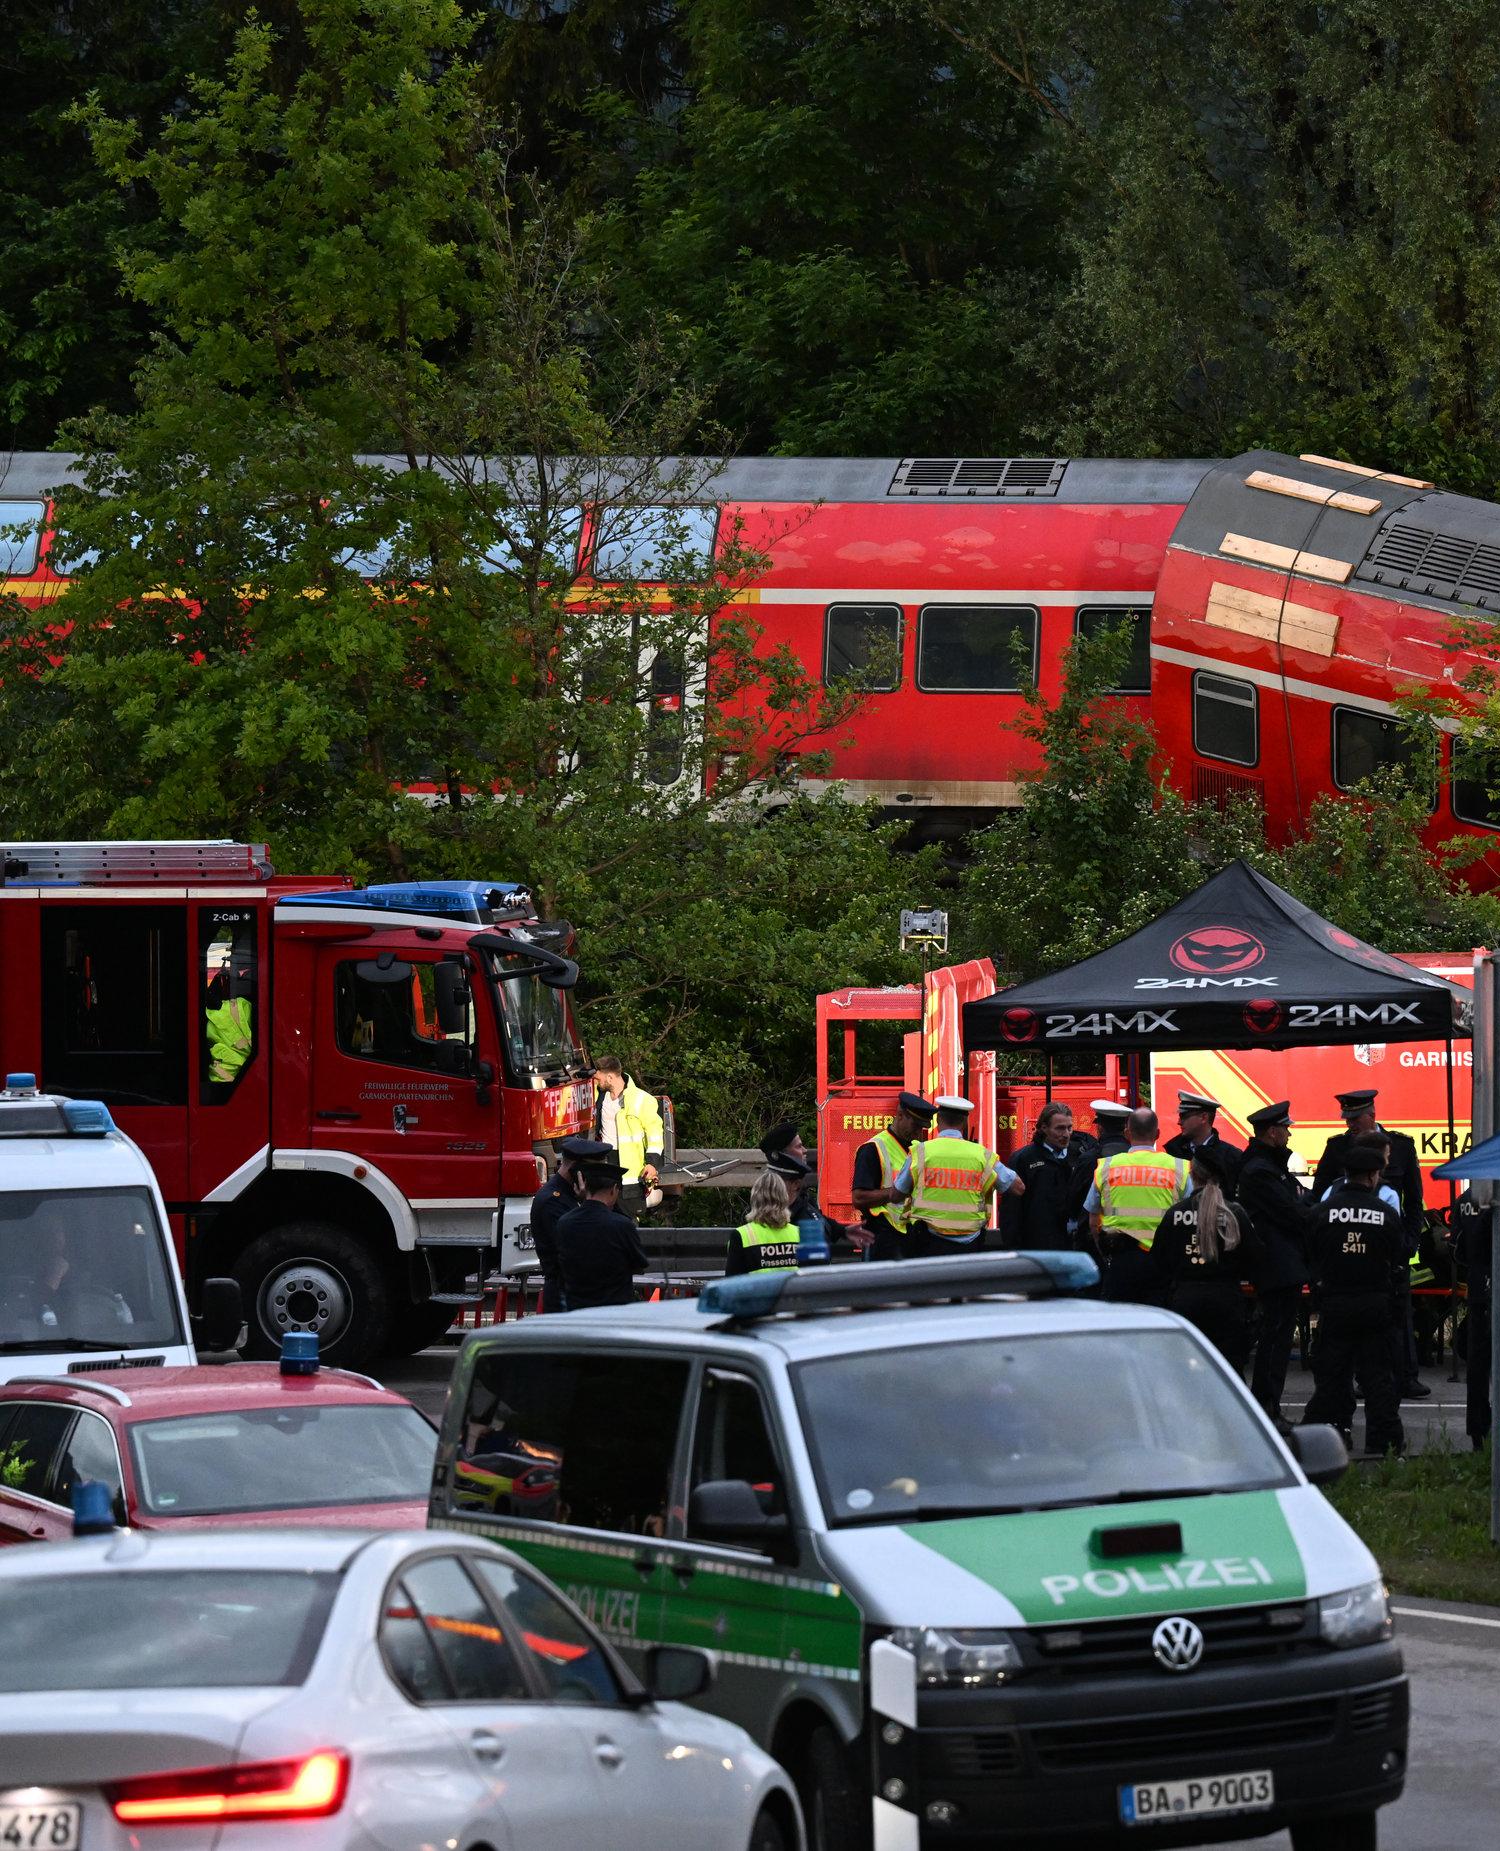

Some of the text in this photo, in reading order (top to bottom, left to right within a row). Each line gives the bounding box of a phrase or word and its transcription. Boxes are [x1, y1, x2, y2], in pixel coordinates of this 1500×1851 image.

[213, 913, 240, 921] Z-Cab
[1133, 976, 1280, 990] 24MX
[1045, 1009, 1182, 1038] 24MX
[1287, 1001, 1425, 1028] 24MX
[364, 1082, 449, 1091] FREIWILLIGE FEUERWEHR
[1328, 1207, 1385, 1226] POLIZEI
[1347, 1232, 1362, 1242] BY
[1342, 1243, 1366, 1254] 5411
[1041, 1557, 1274, 1606] POLIZEI
[1152, 1616, 1204, 1670] VW
[1137, 1774, 1270, 1814] BA P 9003
